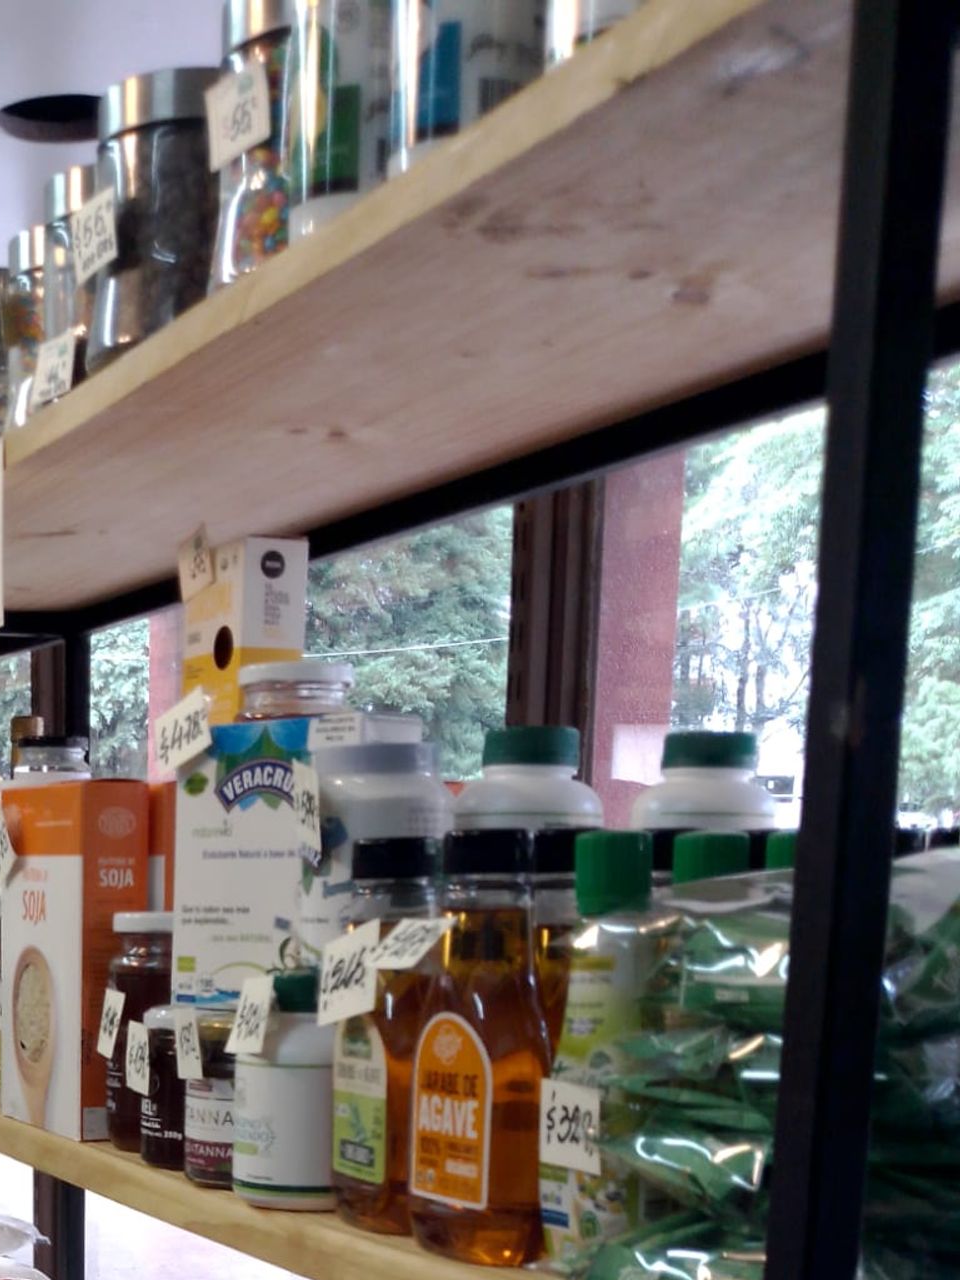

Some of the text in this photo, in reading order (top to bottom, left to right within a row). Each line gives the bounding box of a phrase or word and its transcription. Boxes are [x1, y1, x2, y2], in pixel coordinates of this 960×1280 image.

[221, 764, 295, 801] VERACRU
[99, 868, 135, 889] SOJA
[22, 890, 47, 926] SOJA
[418, 1094, 478, 1140] AGAVE
